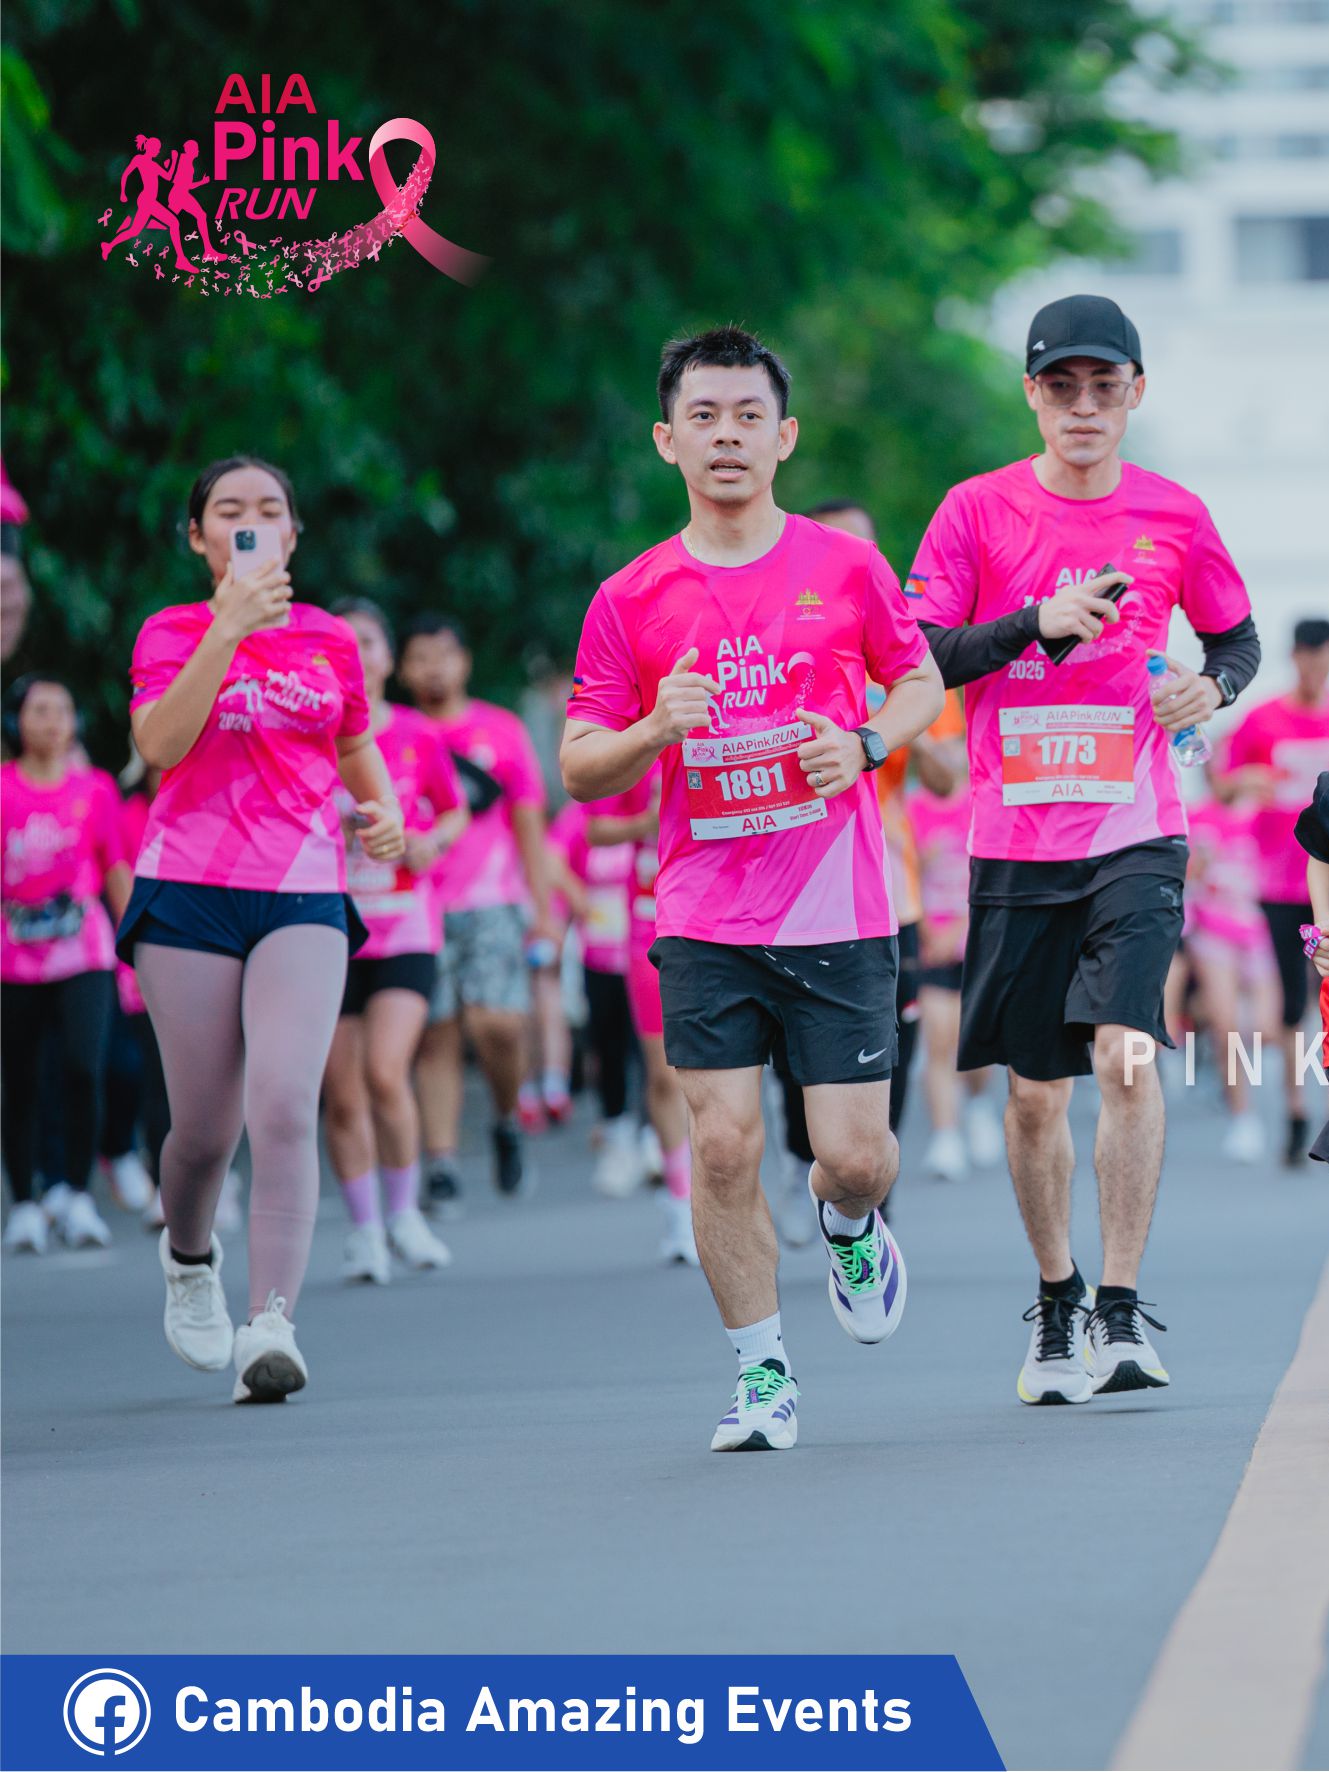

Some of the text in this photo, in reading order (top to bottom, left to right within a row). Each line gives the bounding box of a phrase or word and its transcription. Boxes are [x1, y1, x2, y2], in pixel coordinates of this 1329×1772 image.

[716, 635, 764, 660] AIA
[716, 654, 787, 691] Pink
[1008, 660, 1045, 680] 2025
[722, 688, 767, 709] RUN
[1037, 735, 1097, 765] 1773
[715, 762, 786, 801] 1891
[1051, 783, 1084, 797] AIA
[742, 814, 777, 832] AIA
